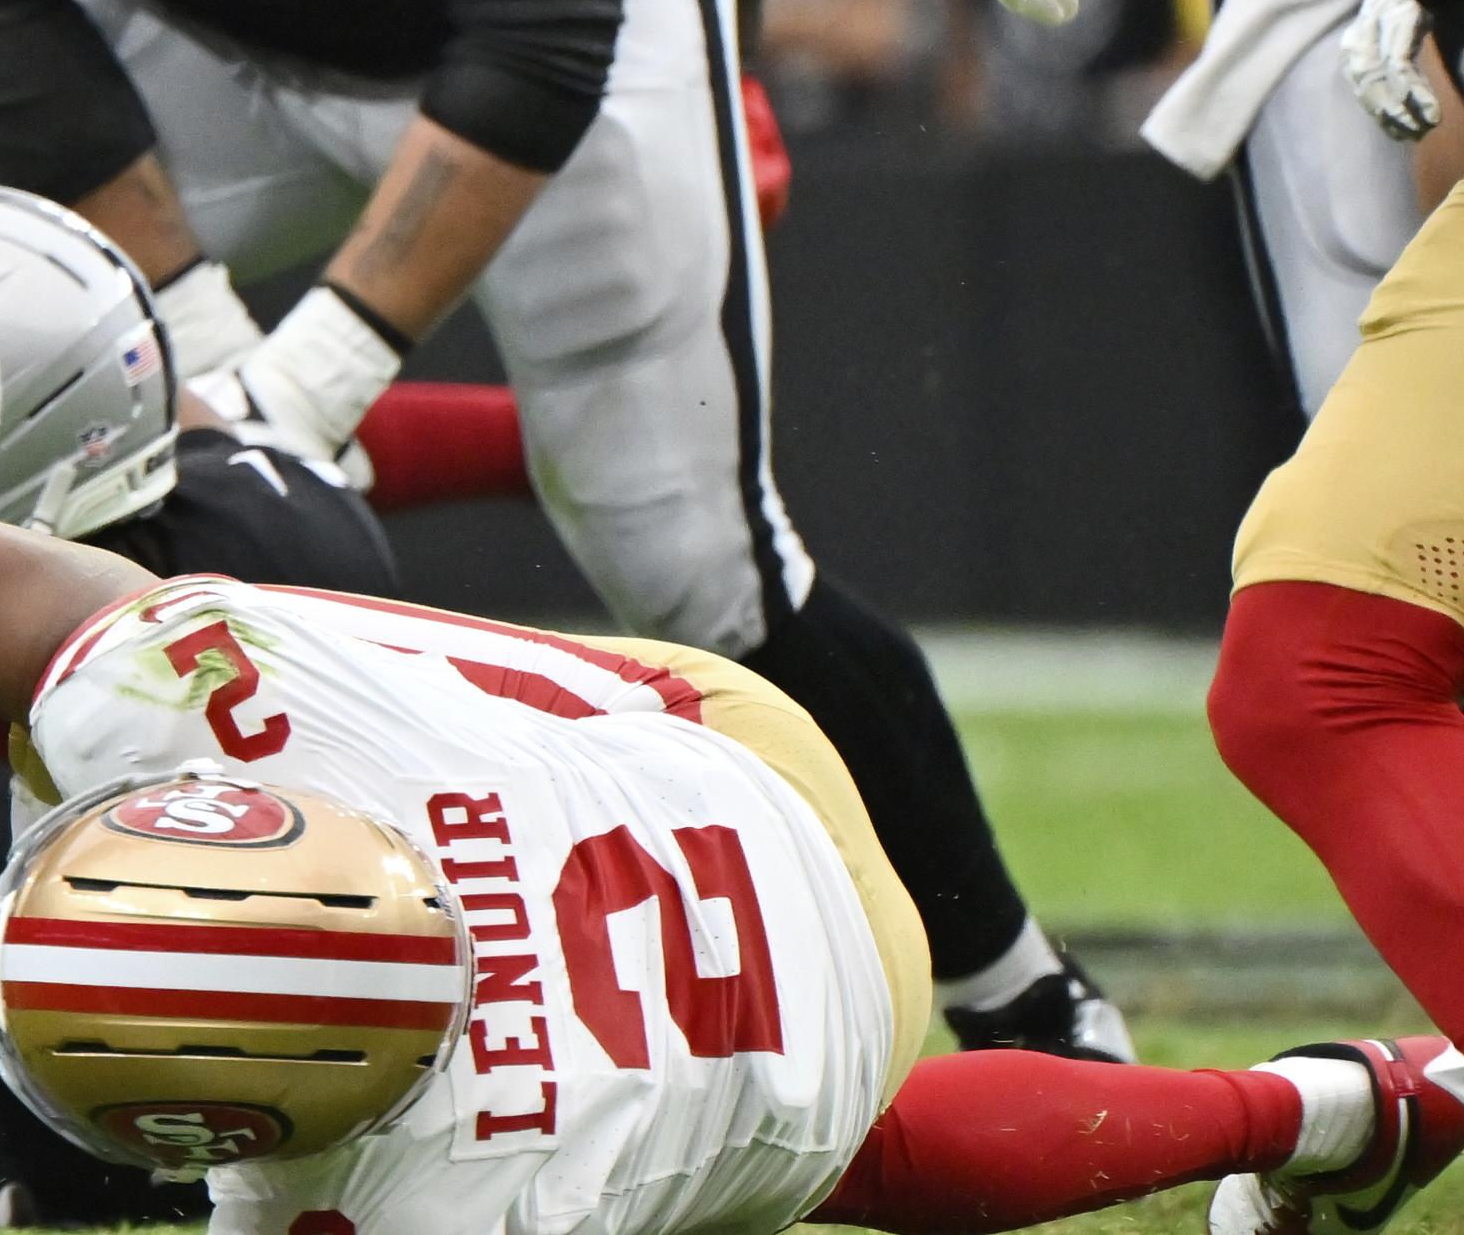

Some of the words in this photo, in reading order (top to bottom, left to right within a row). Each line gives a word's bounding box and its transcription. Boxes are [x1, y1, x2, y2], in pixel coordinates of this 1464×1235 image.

[162, 618, 292, 764] 2
[426, 791, 558, 1142] LENOIR
[551, 823, 785, 1071] 2
